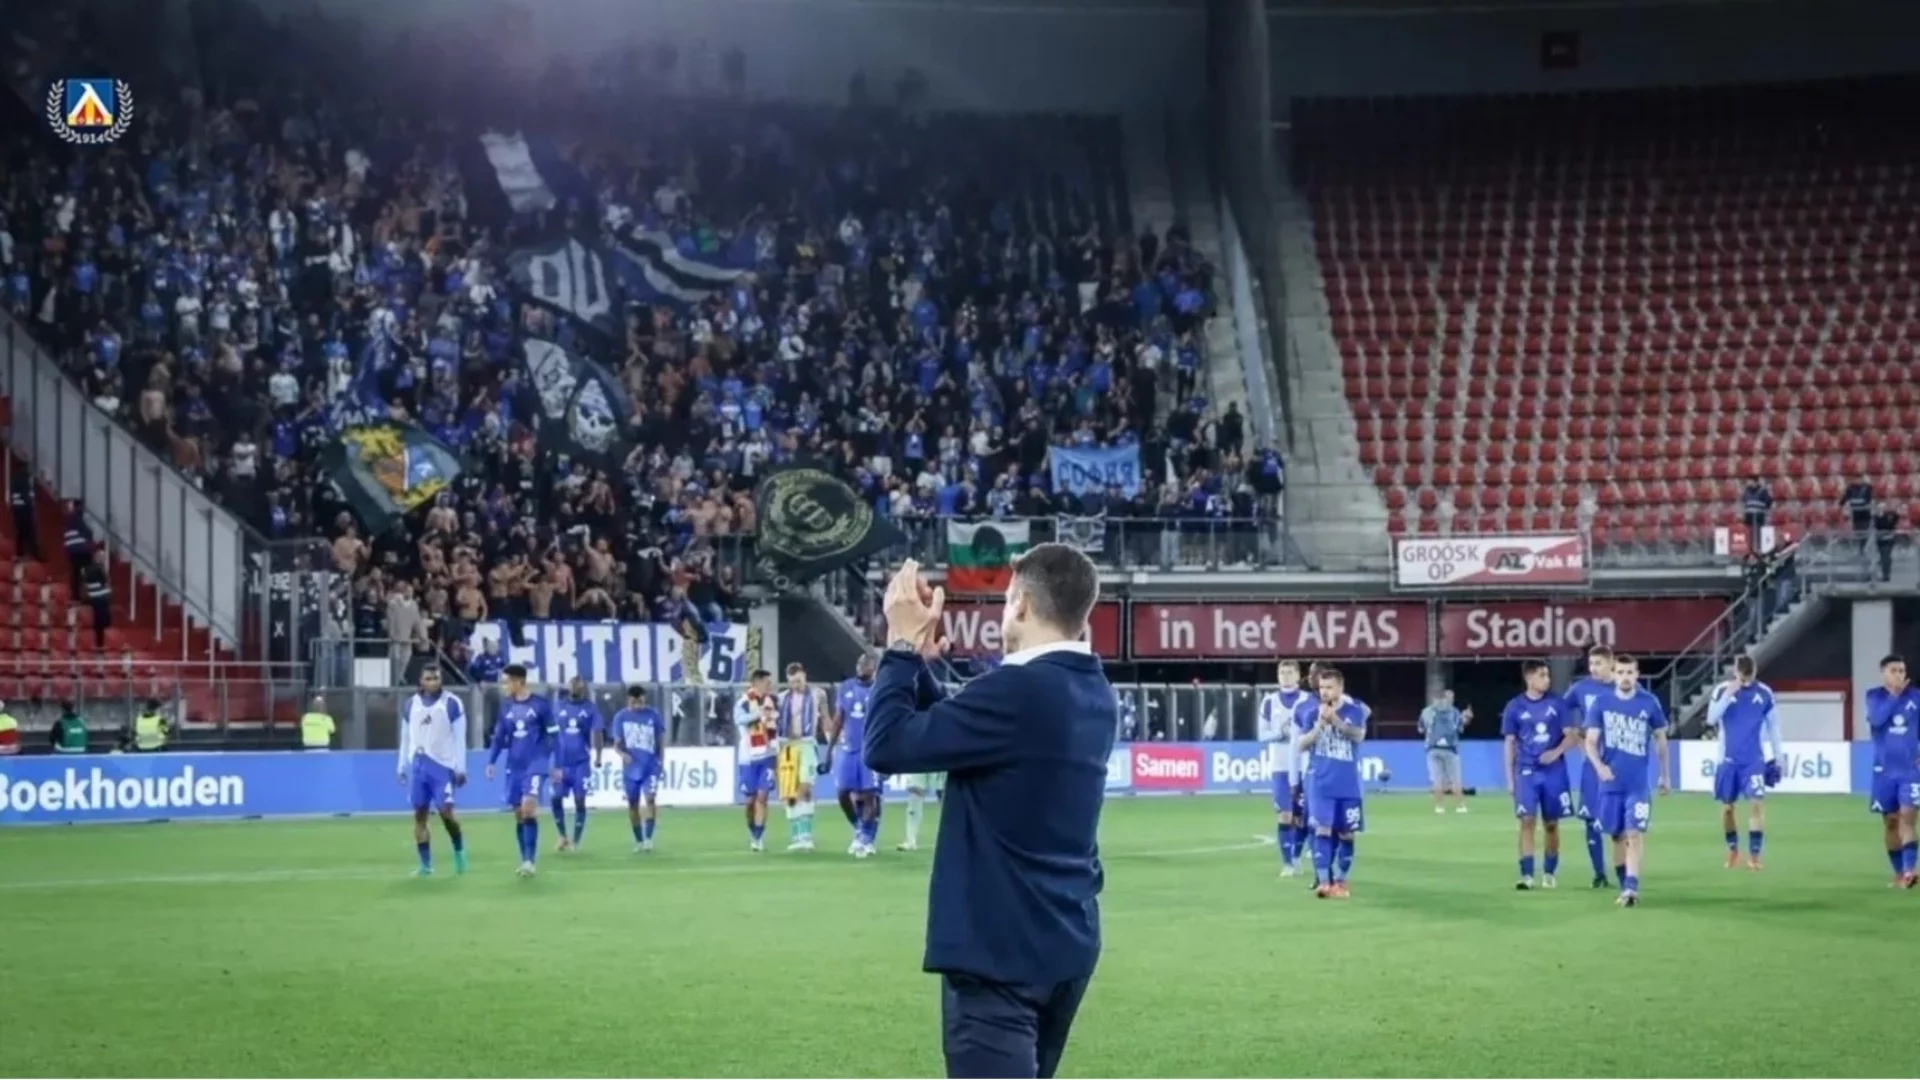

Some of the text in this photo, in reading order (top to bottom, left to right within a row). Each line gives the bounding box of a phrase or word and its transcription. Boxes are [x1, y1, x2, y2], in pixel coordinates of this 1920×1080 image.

[1427, 563, 1455, 580] OP
[1159, 609, 1195, 649] in
[1213, 608, 1277, 649] het
[1297, 609, 1400, 649] AFAS
[1466, 606, 1616, 649] Stadion
[1136, 753, 1199, 777] Samen
